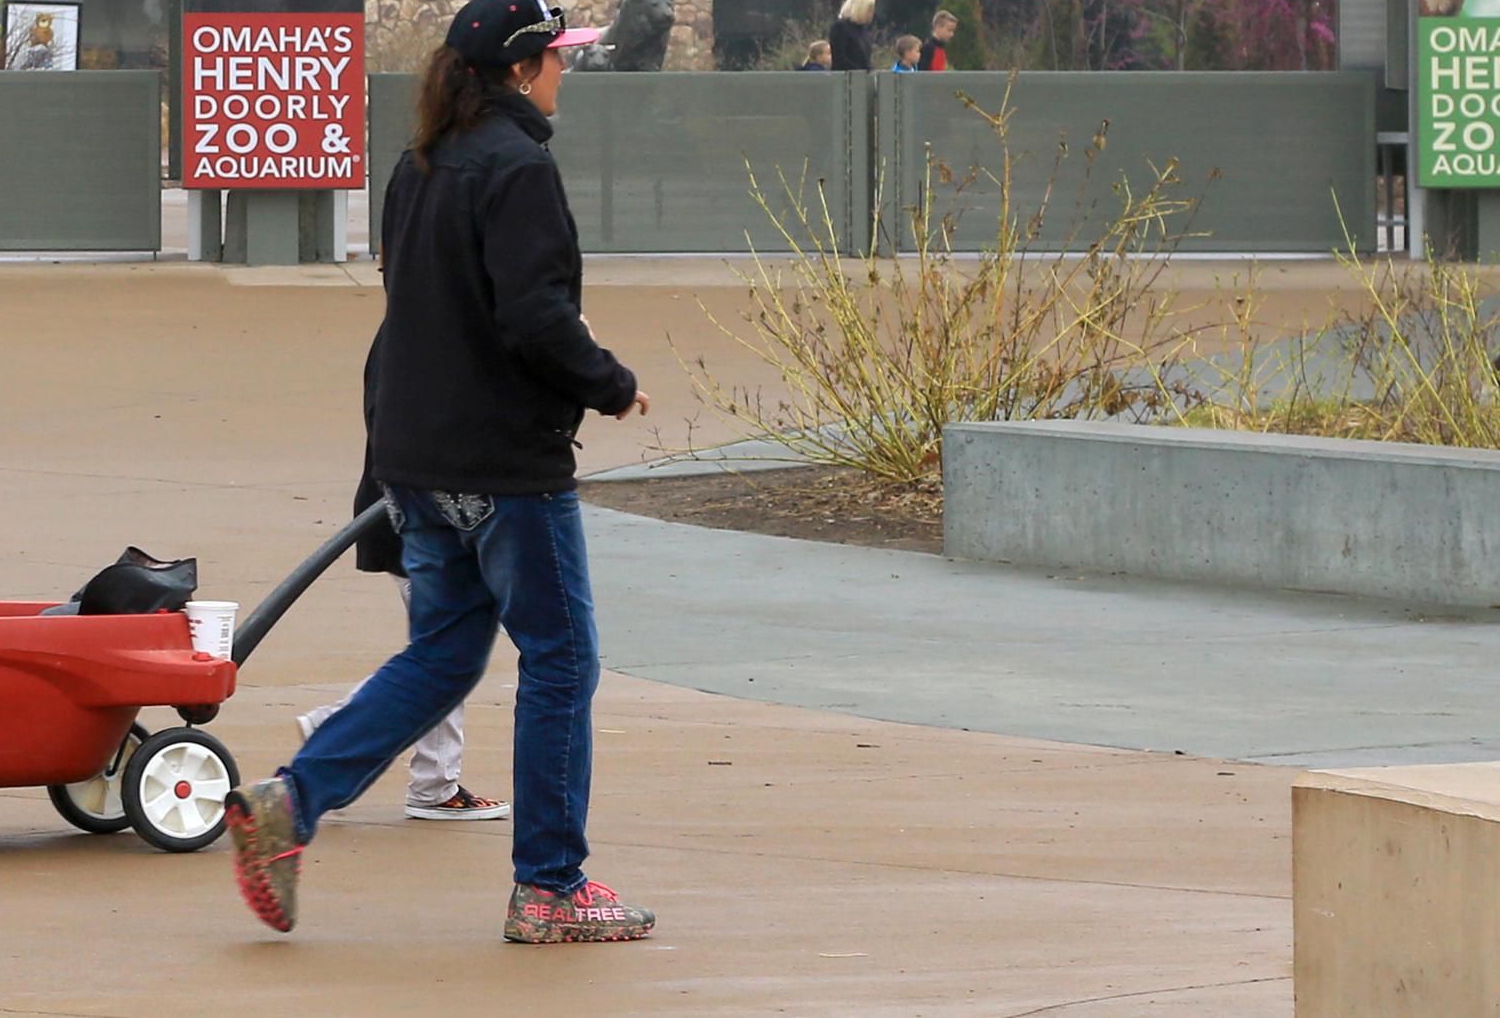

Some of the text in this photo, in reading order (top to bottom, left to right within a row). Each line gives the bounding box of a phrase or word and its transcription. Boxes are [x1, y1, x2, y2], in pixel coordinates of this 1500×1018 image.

[192, 26, 353, 53] OMAHA'S
[193, 57, 351, 91] HENRY
[195, 94, 350, 120] DOORLY
[195, 123, 351, 154] ZOO &
[1432, 154, 1500, 175] AQU
[523, 903, 626, 922] REALTREE
